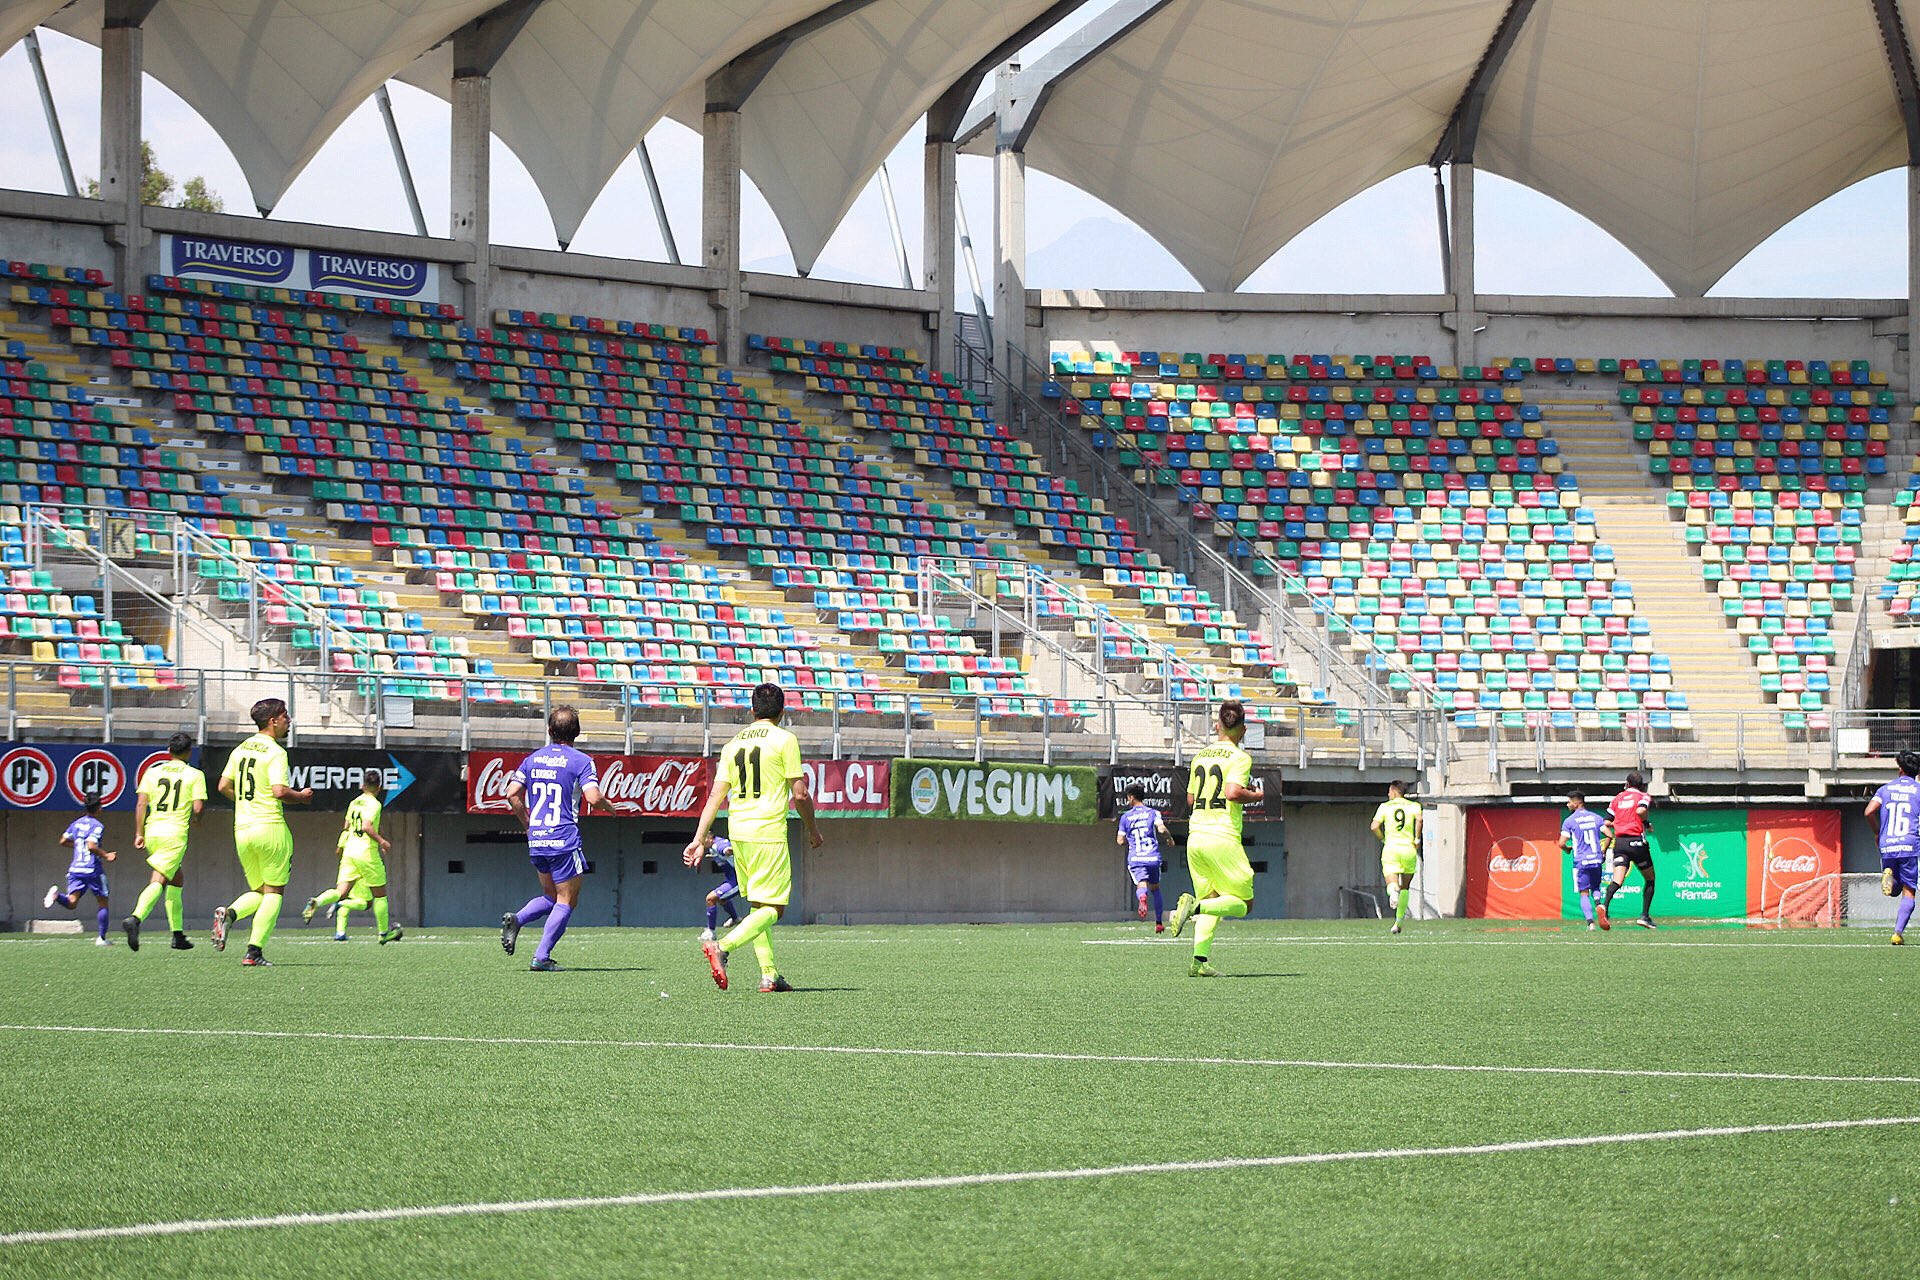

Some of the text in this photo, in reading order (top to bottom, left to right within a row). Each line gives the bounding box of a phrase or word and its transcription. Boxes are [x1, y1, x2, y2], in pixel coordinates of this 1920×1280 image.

[182, 240, 282, 266] TRAVERSO
[319, 255, 416, 281] TRAVERSO
[111, 522, 130, 554] K
[1198, 748, 1234, 759] IGUERAS
[12, 758, 41, 795] PF
[82, 761, 111, 797] PF
[239, 757, 257, 801] 15
[288, 765, 402, 790] WERADE
[734, 745, 761, 799] 11
[800, 762, 882, 804] OL.CL
[1194, 763, 1227, 810] 22
[156, 777, 183, 812] 21
[529, 782, 562, 827] 23
[942, 768, 1063, 818] VEGUM
[1394, 808, 1406, 832] 9
[1885, 802, 1911, 837] 16
[1131, 827, 1155, 853] 15
[1583, 829, 1597, 853] 4
[1489, 855, 1539, 872] Coca-Cola
[1769, 855, 1817, 873] Coca-Cola
[1672, 880, 1713, 888] Patrimonio
[1682, 889, 1718, 900] Familia
